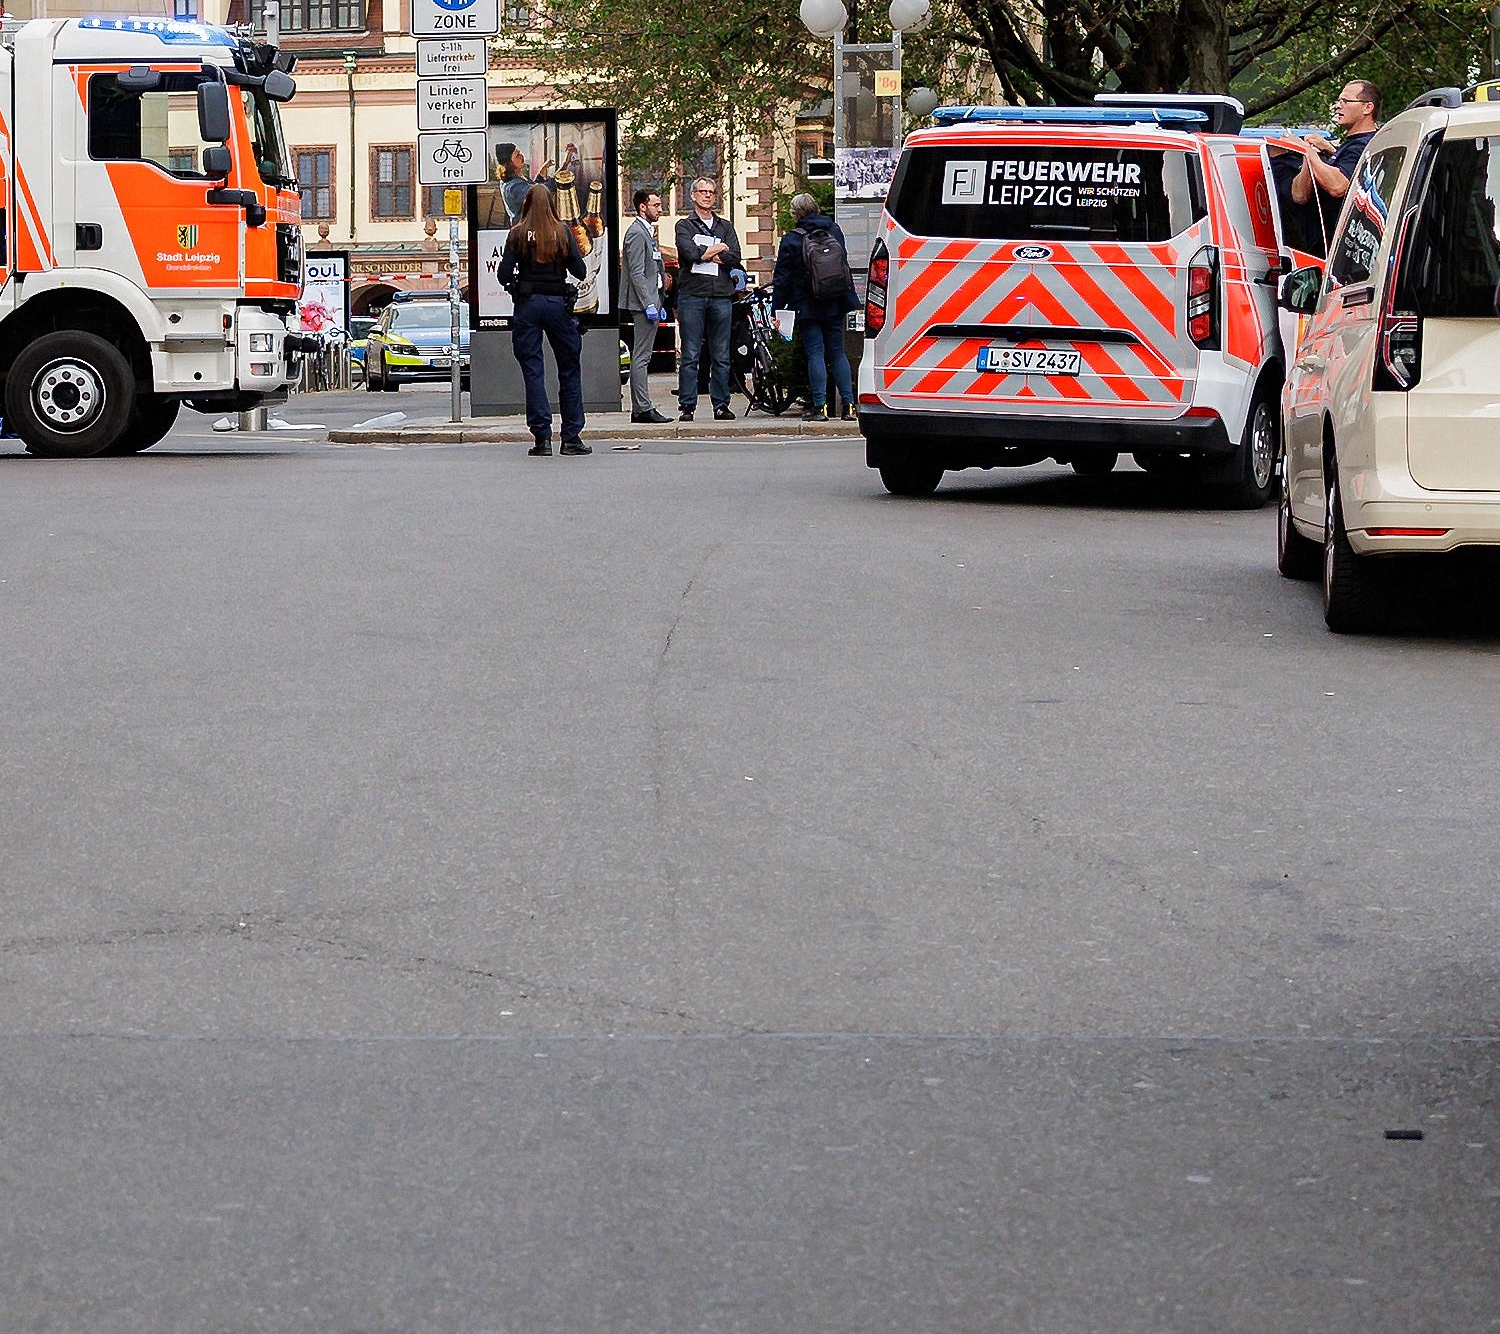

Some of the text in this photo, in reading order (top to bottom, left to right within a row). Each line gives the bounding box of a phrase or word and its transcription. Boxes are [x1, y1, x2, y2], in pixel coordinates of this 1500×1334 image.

[434, 15, 477, 29] ZONE
[427, 53, 476, 63] Lieferverkehr
[443, 64, 461, 73] frei
[429, 84, 474, 96] Linien-
[427, 99, 477, 110] verkehr
[442, 114, 463, 125] frei
[442, 167, 464, 178] frei
[990, 160, 1141, 184] FEUERWEHR
[988, 185, 1072, 207] LEIPZIG
[1078, 186, 1140, 197] WIR SCHÜTZEN
[1076, 198, 1108, 208] LEIPZIG
[156, 252, 221, 264] Stadt Leipzig
[1020, 246, 1045, 259] Ford
[366, 263, 422, 272] SCHNEIDER
[990, 351, 999, 366] L
[1012, 352, 1033, 367] SV
[1036, 353, 1078, 369] 2437
